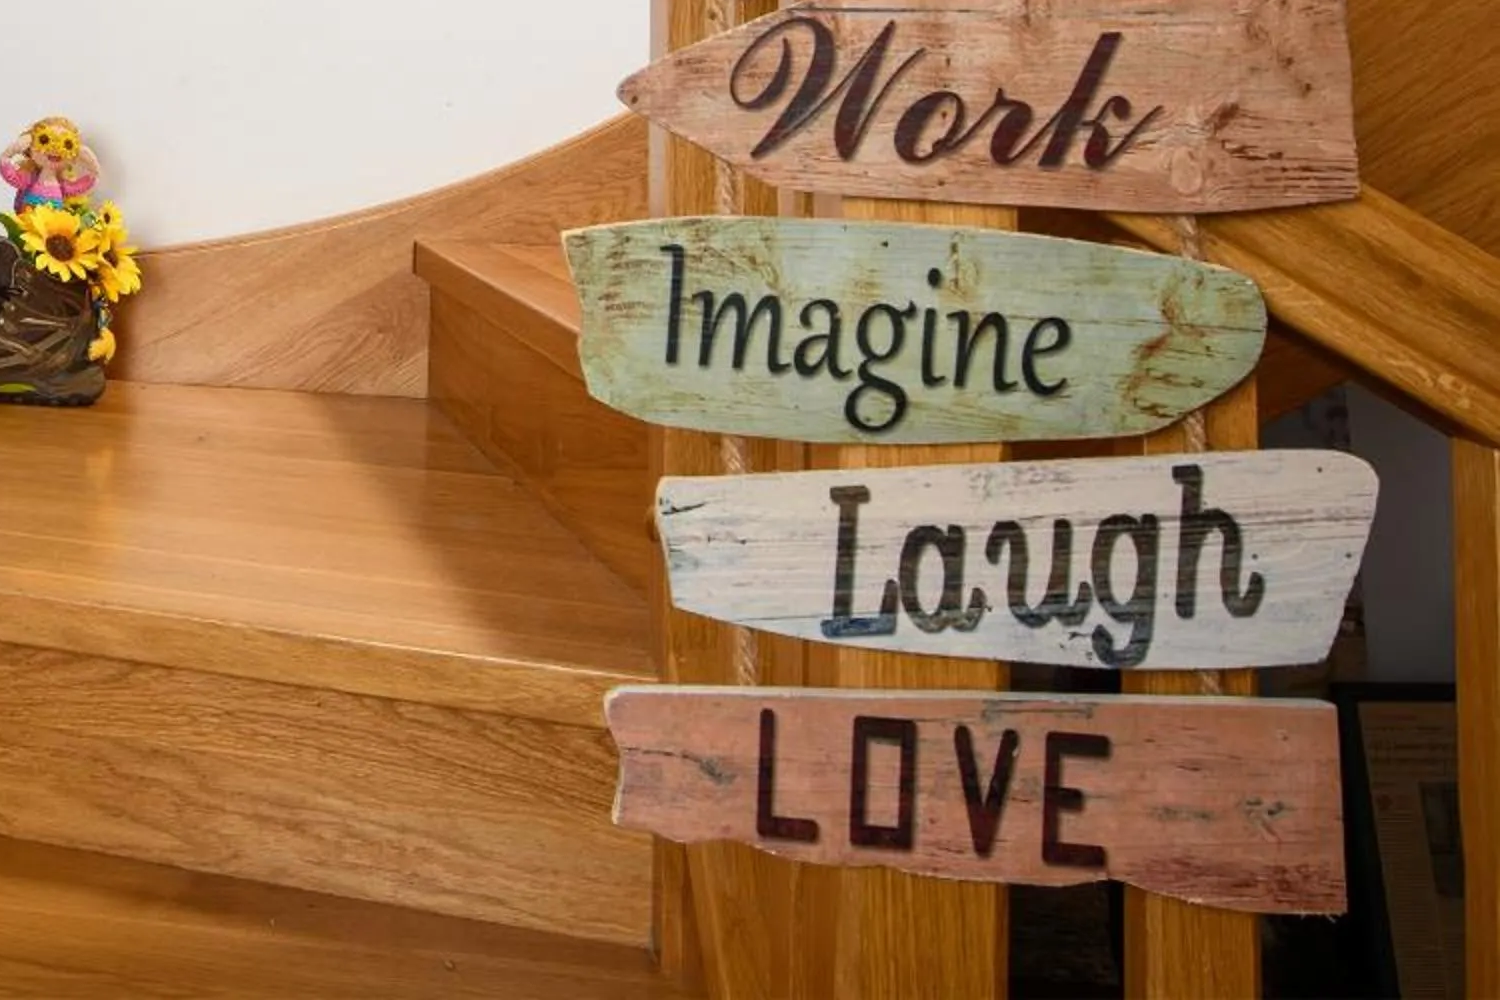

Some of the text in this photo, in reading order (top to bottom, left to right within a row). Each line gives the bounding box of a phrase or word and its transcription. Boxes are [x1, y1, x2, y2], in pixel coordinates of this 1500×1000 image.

[729, 16, 1164, 171] Work
[659, 244, 1071, 433] Imagine
[820, 465, 1265, 668] Laugh
[756, 708, 1111, 868] LOVE
